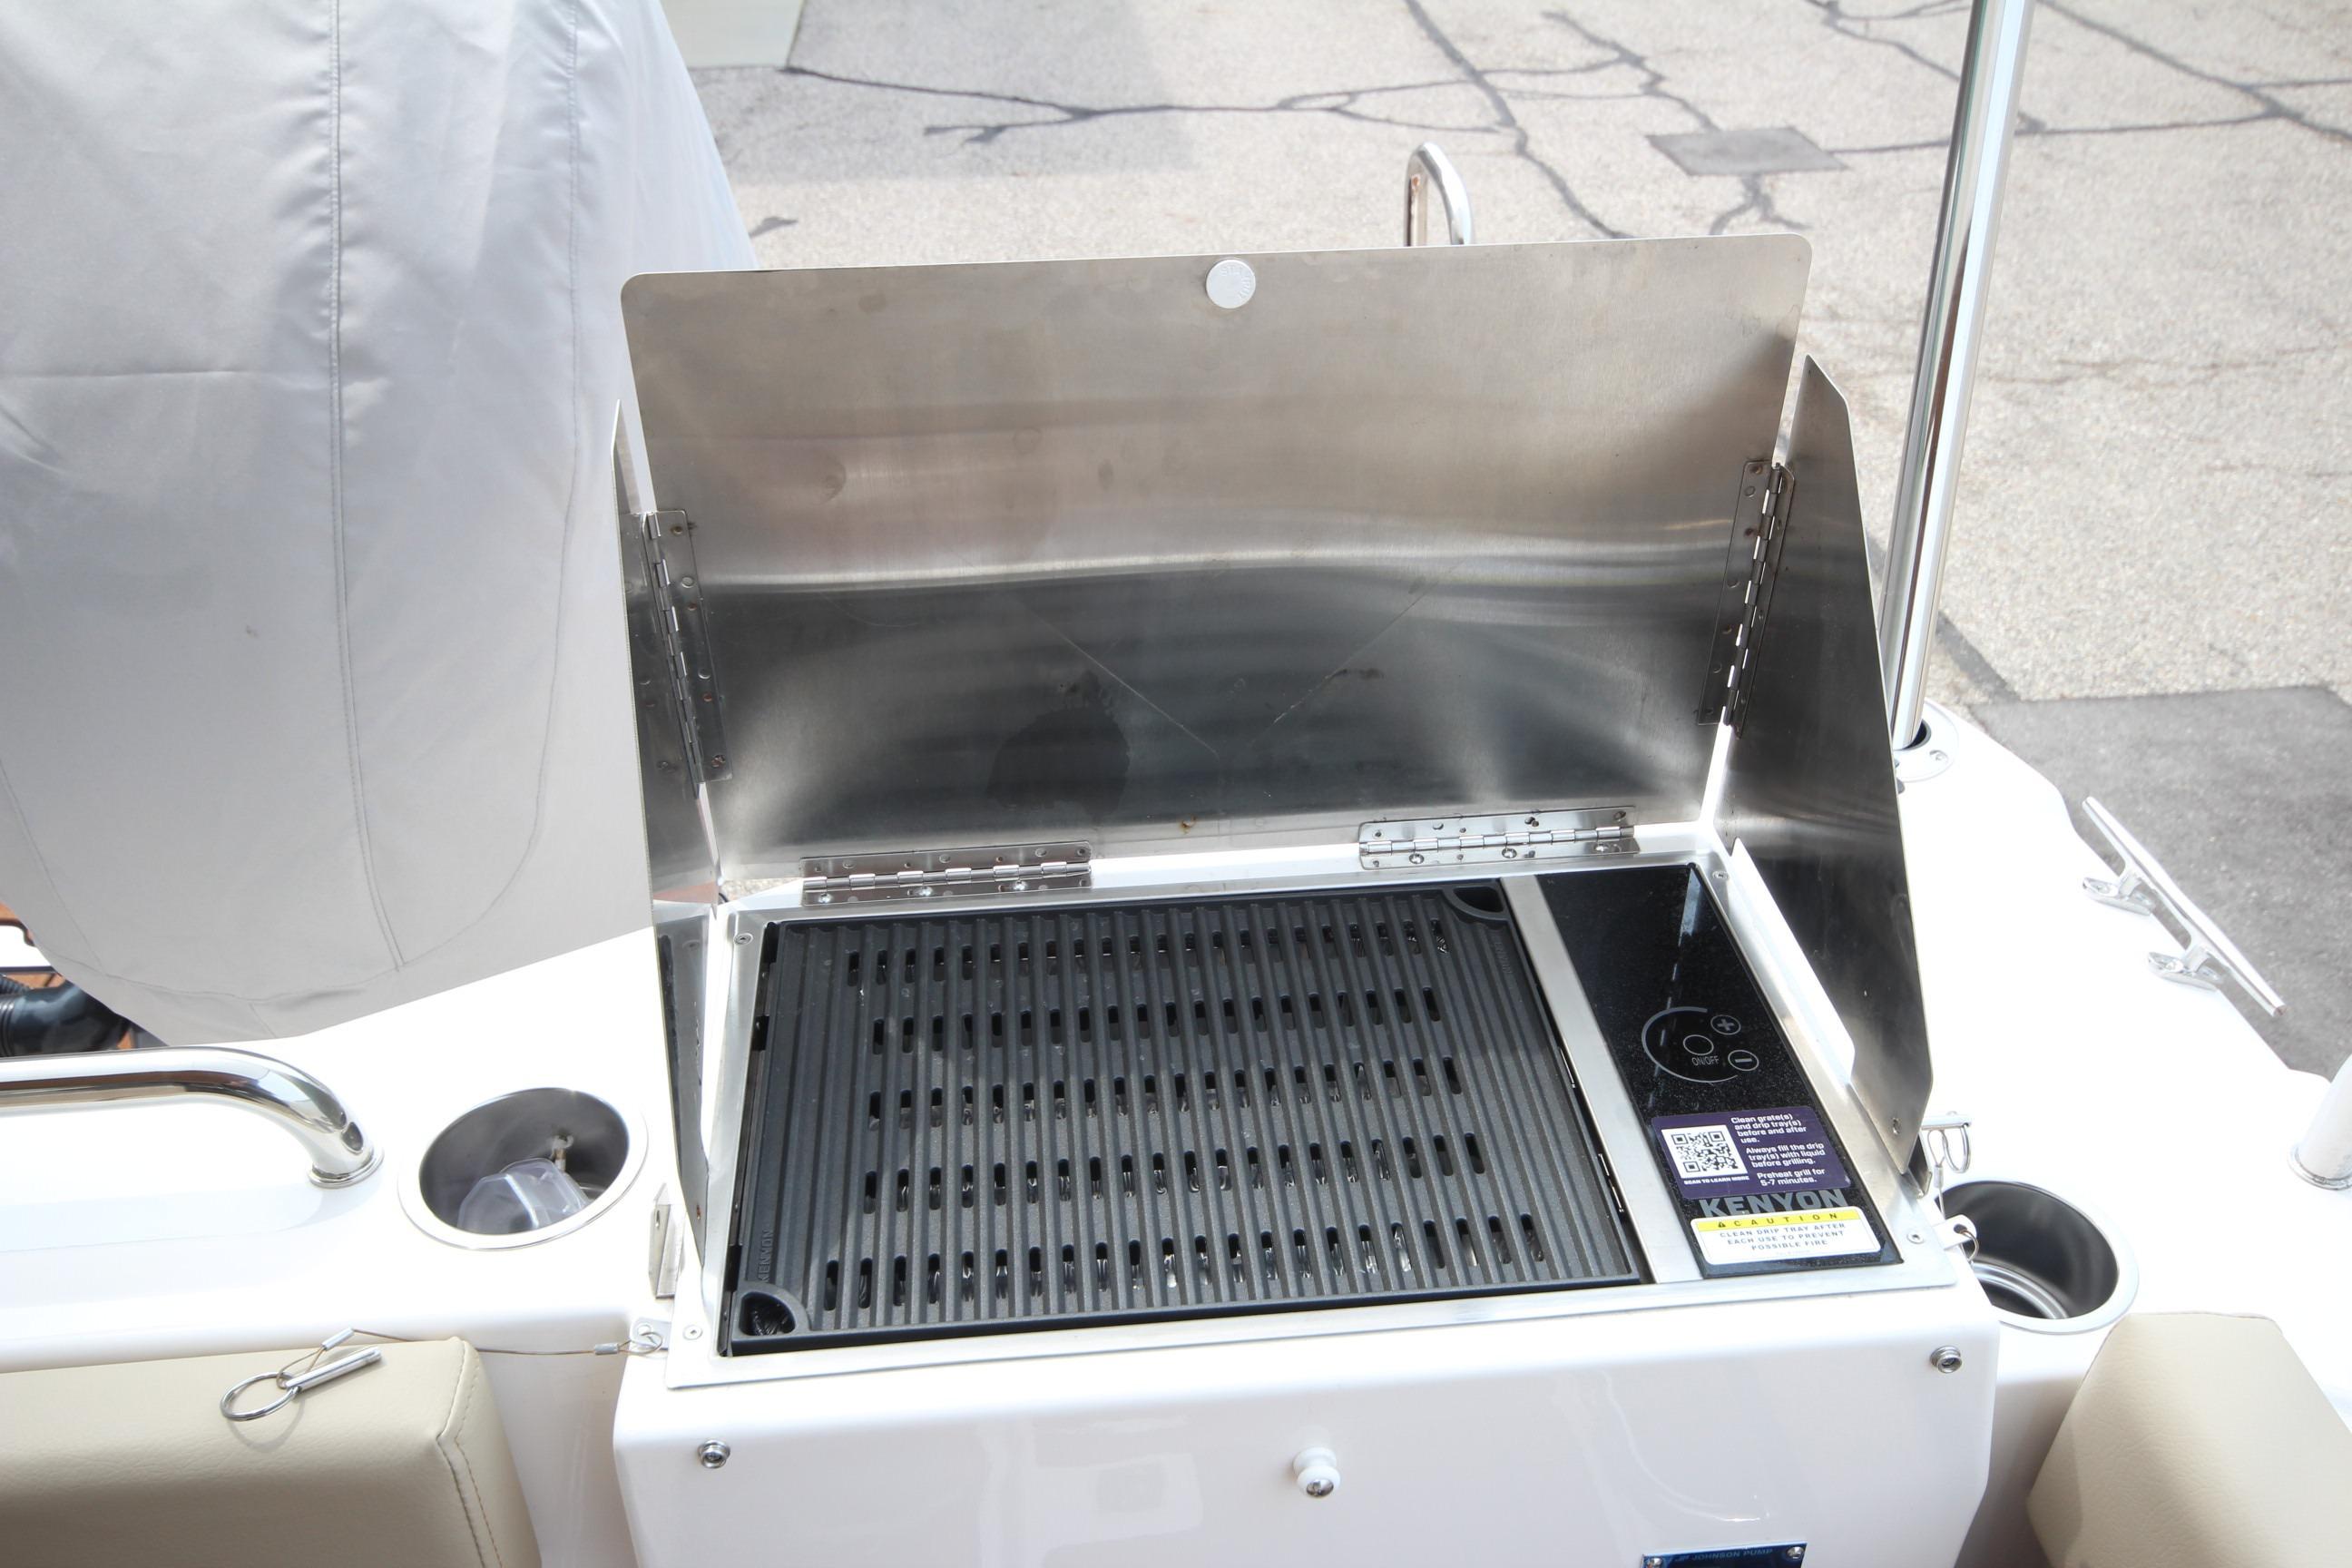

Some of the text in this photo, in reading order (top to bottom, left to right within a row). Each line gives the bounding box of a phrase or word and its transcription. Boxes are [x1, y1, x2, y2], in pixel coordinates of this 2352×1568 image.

[1691, 1055, 1720, 1066] ON/OFF
[1730, 1113, 1793, 1124] Clean grate(s)
[1735, 1120, 1802, 1131] and drip tray(s)
[1737, 1129, 1767, 1137] before
[1768, 1127, 1785, 1135] and
[1746, 1146, 1777, 1154] Always
[1806, 1142, 1825, 1151] drip
[1748, 1149, 1826, 1161] tray(s) with liquid
[1751, 1157, 1816, 1168] before grilling.
[1757, 1171, 1793, 1180] Preheat
[1794, 1169, 1811, 1178] grill
[1759, 1176, 1817, 1187] 5-7 minutes.
[1699, 1189, 1849, 1218] KENYON
[1733, 1213, 1838, 1227] CAUTION
[1720, 1230, 1753, 1238] CLEAN
[1783, 1225, 1808, 1233] TRAY
[1798, 1230, 1846, 1240] PREVENT
[1751, 1241, 1801, 1250] POSSIBLE
[1691, 1550, 1740, 1561] JOHNSON
[1742, 1548, 1773, 1556] PUMP
